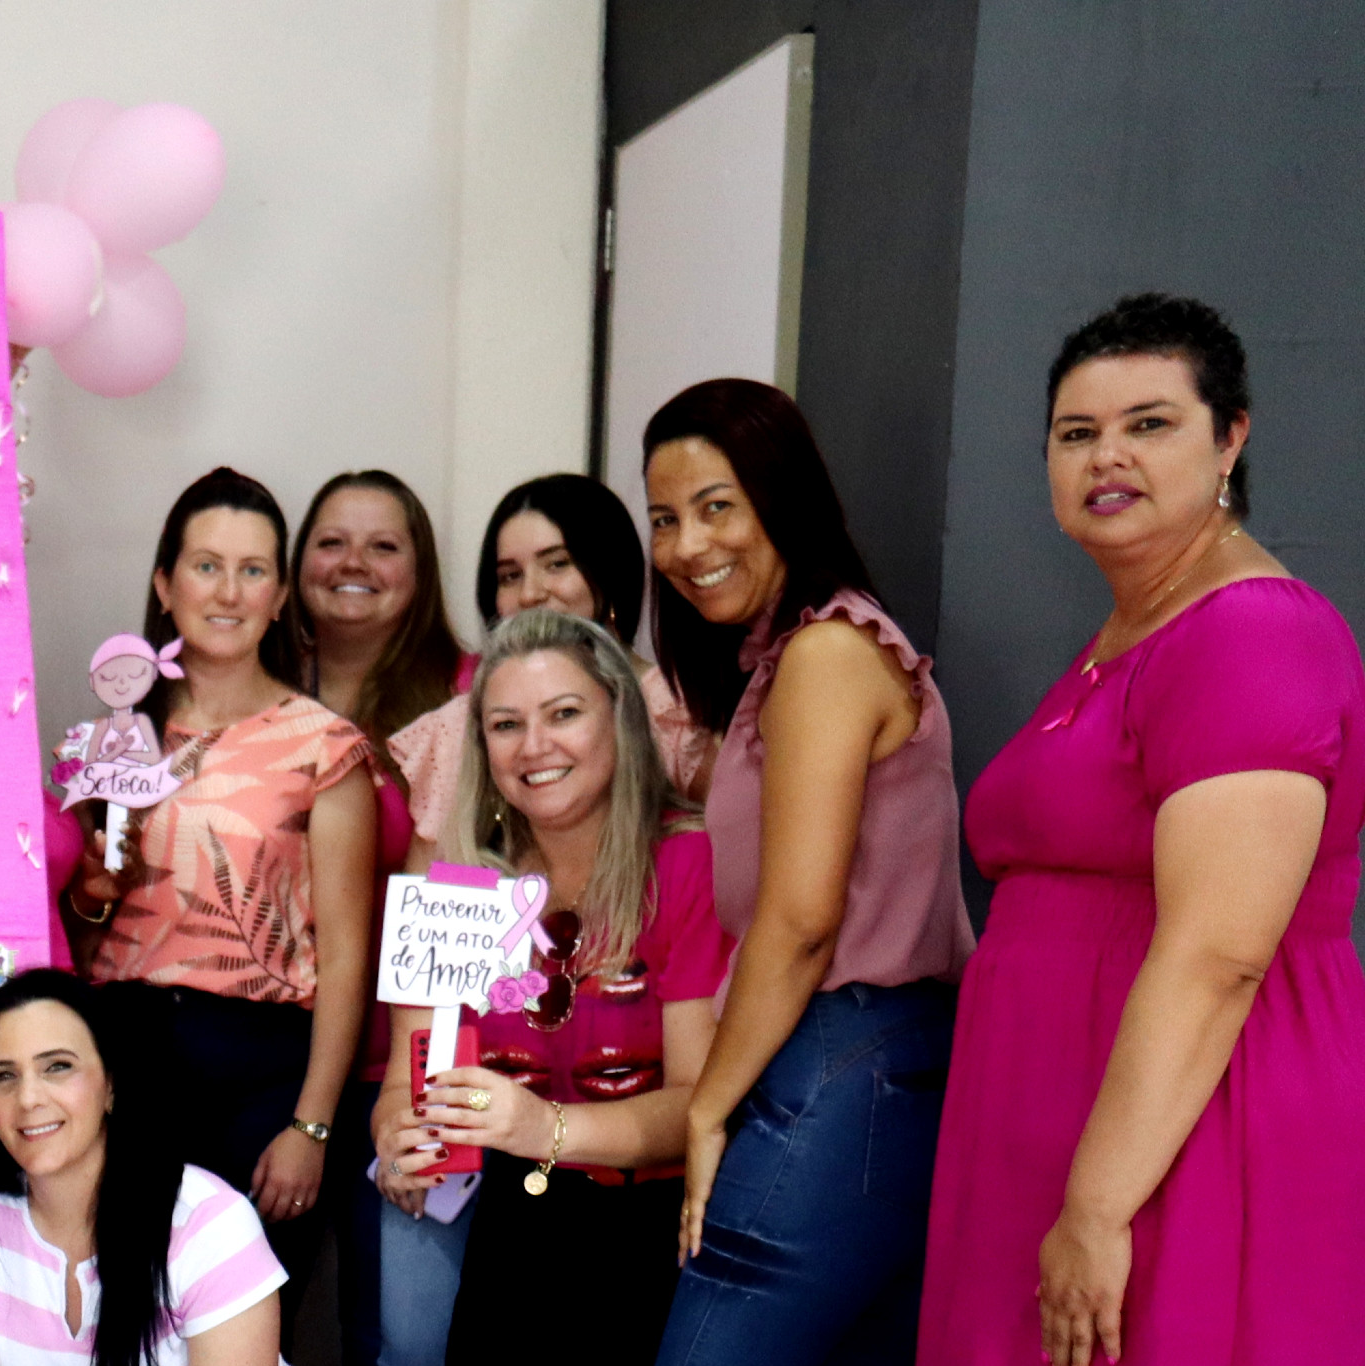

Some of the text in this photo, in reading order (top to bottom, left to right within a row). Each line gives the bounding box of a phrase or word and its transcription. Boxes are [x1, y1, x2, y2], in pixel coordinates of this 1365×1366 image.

[400, 884, 507, 925] Prevenir
[418, 928, 447, 945] UM
[455, 932, 493, 950] ATO
[391, 944, 492, 998] de Amor
